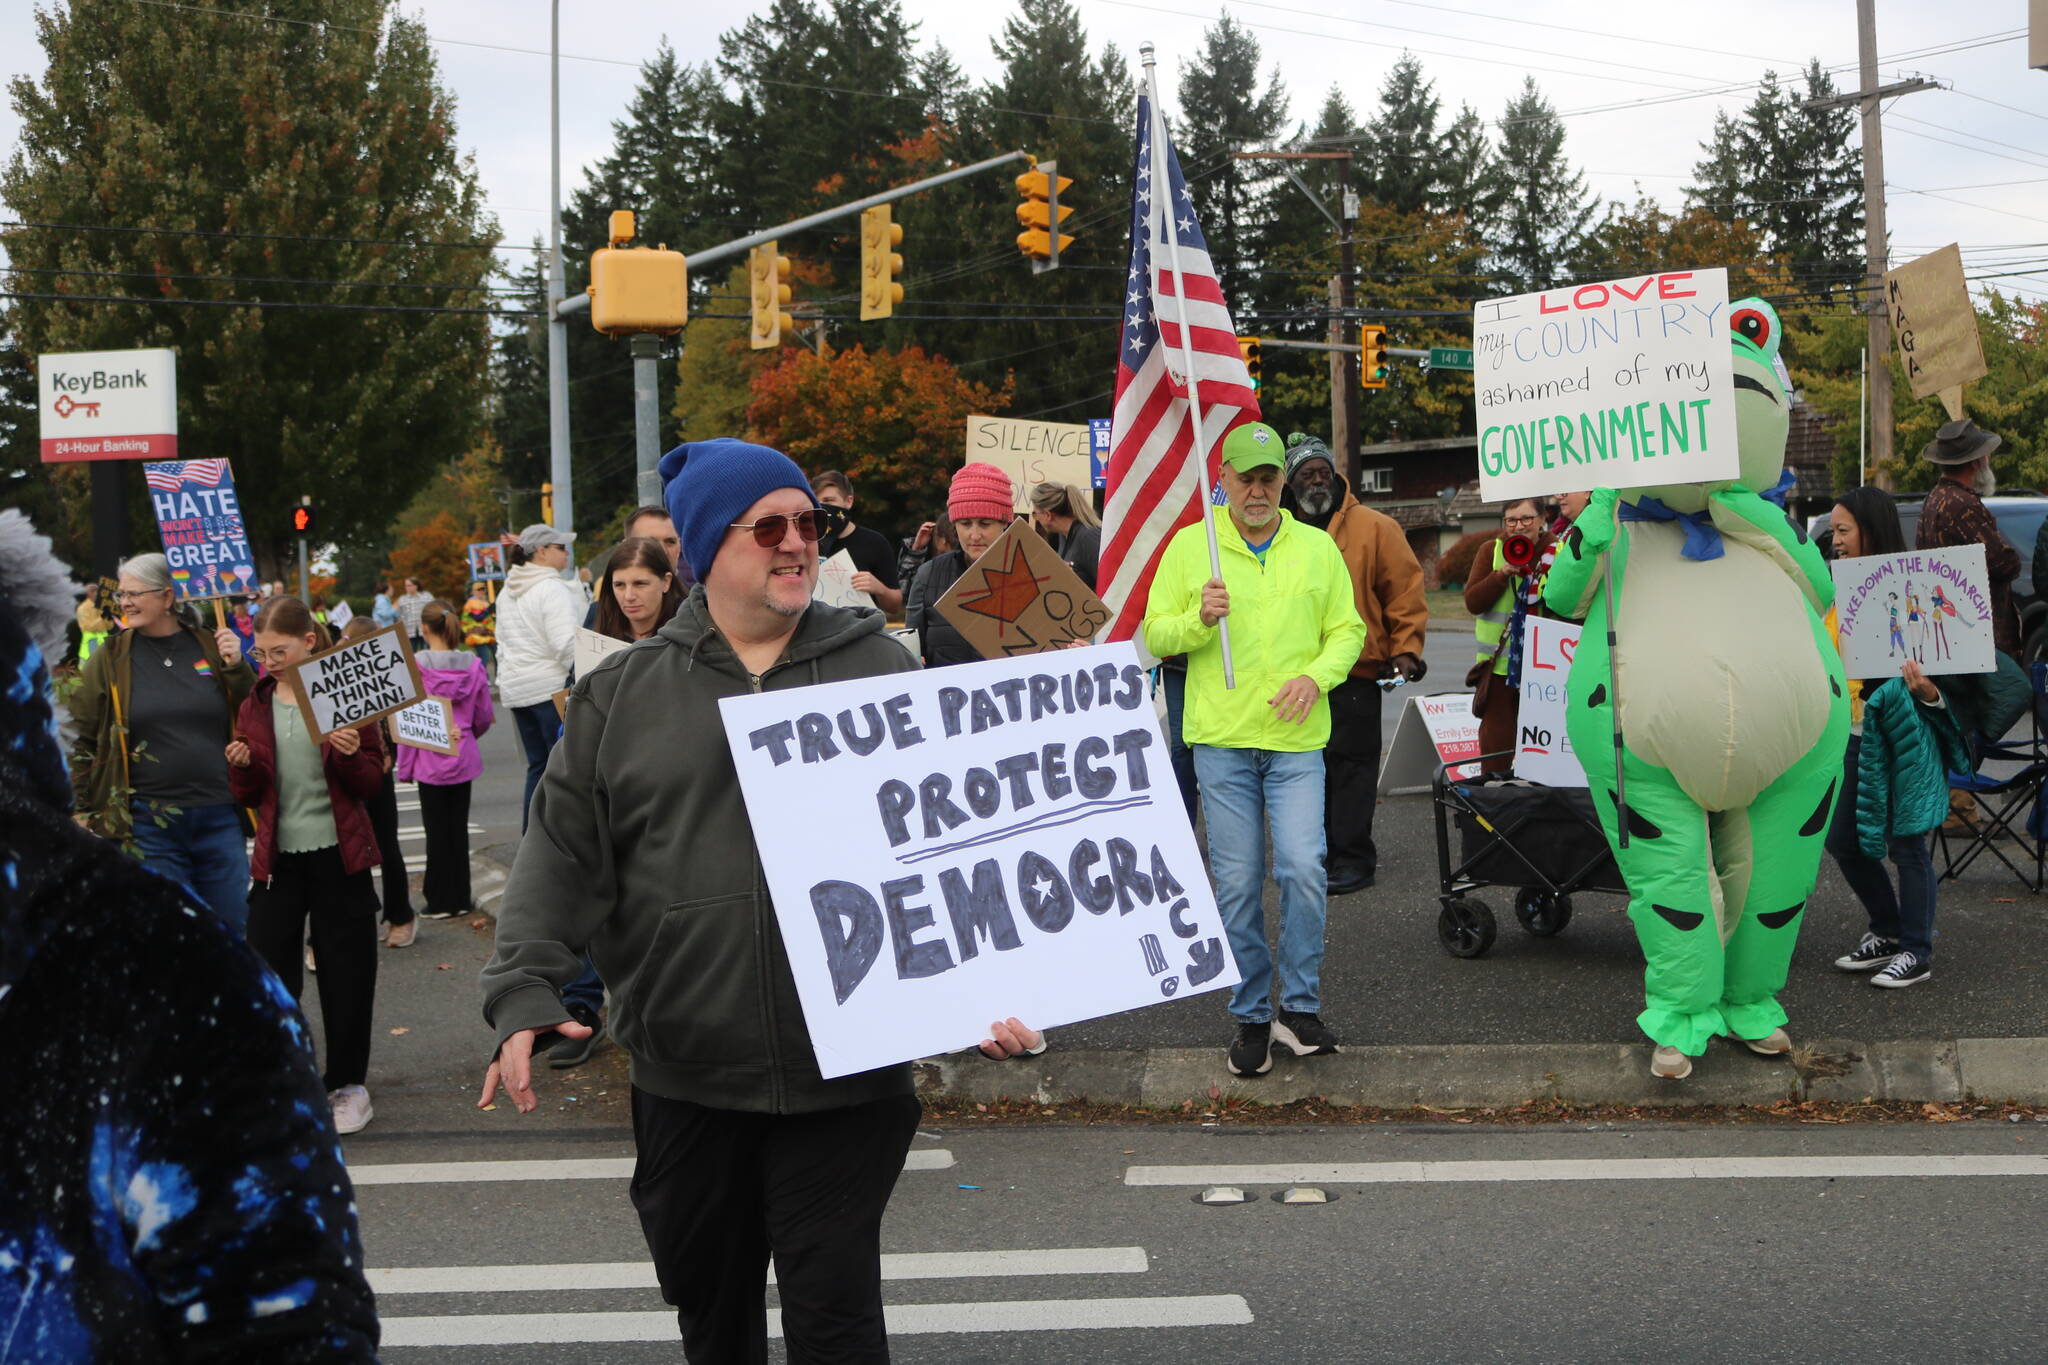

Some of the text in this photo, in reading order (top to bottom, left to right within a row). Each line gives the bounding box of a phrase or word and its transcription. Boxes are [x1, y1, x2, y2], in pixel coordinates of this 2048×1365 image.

[1480, 273, 1696, 324] I LOVE
[1478, 302, 1723, 370] my COUNTRY
[1441, 352, 1458, 364] 140
[53, 369, 148, 394] KeyBank
[1482, 353, 1710, 407] ashamed of my
[56, 440, 149, 454] 24-Hour Banking
[977, 422, 1090, 456] SILENCE
[1481, 398, 1711, 477] GOVERNMENT
[1022, 459, 1046, 484] IS
[153, 489, 239, 520] HATE
[160, 518, 203, 531] WON'T
[163, 515, 245, 546] MAKE US
[166, 541, 247, 568] GREAT
[1840, 557, 1990, 636] TAKE DOWN THE MONARCHY
[320, 639, 382, 675] MAKE
[311, 651, 404, 699] AMERICA
[329, 673, 395, 708] THINK
[333, 686, 406, 729] AGAIN!
[402, 711, 441, 729] BETTER
[427, 704, 441, 716] BE
[749, 662, 1143, 767] TRUE PATRIOTS
[400, 723, 448, 744] HUMANS
[1435, 728, 1461, 739] Emily
[876, 728, 1153, 848] PROTECT
